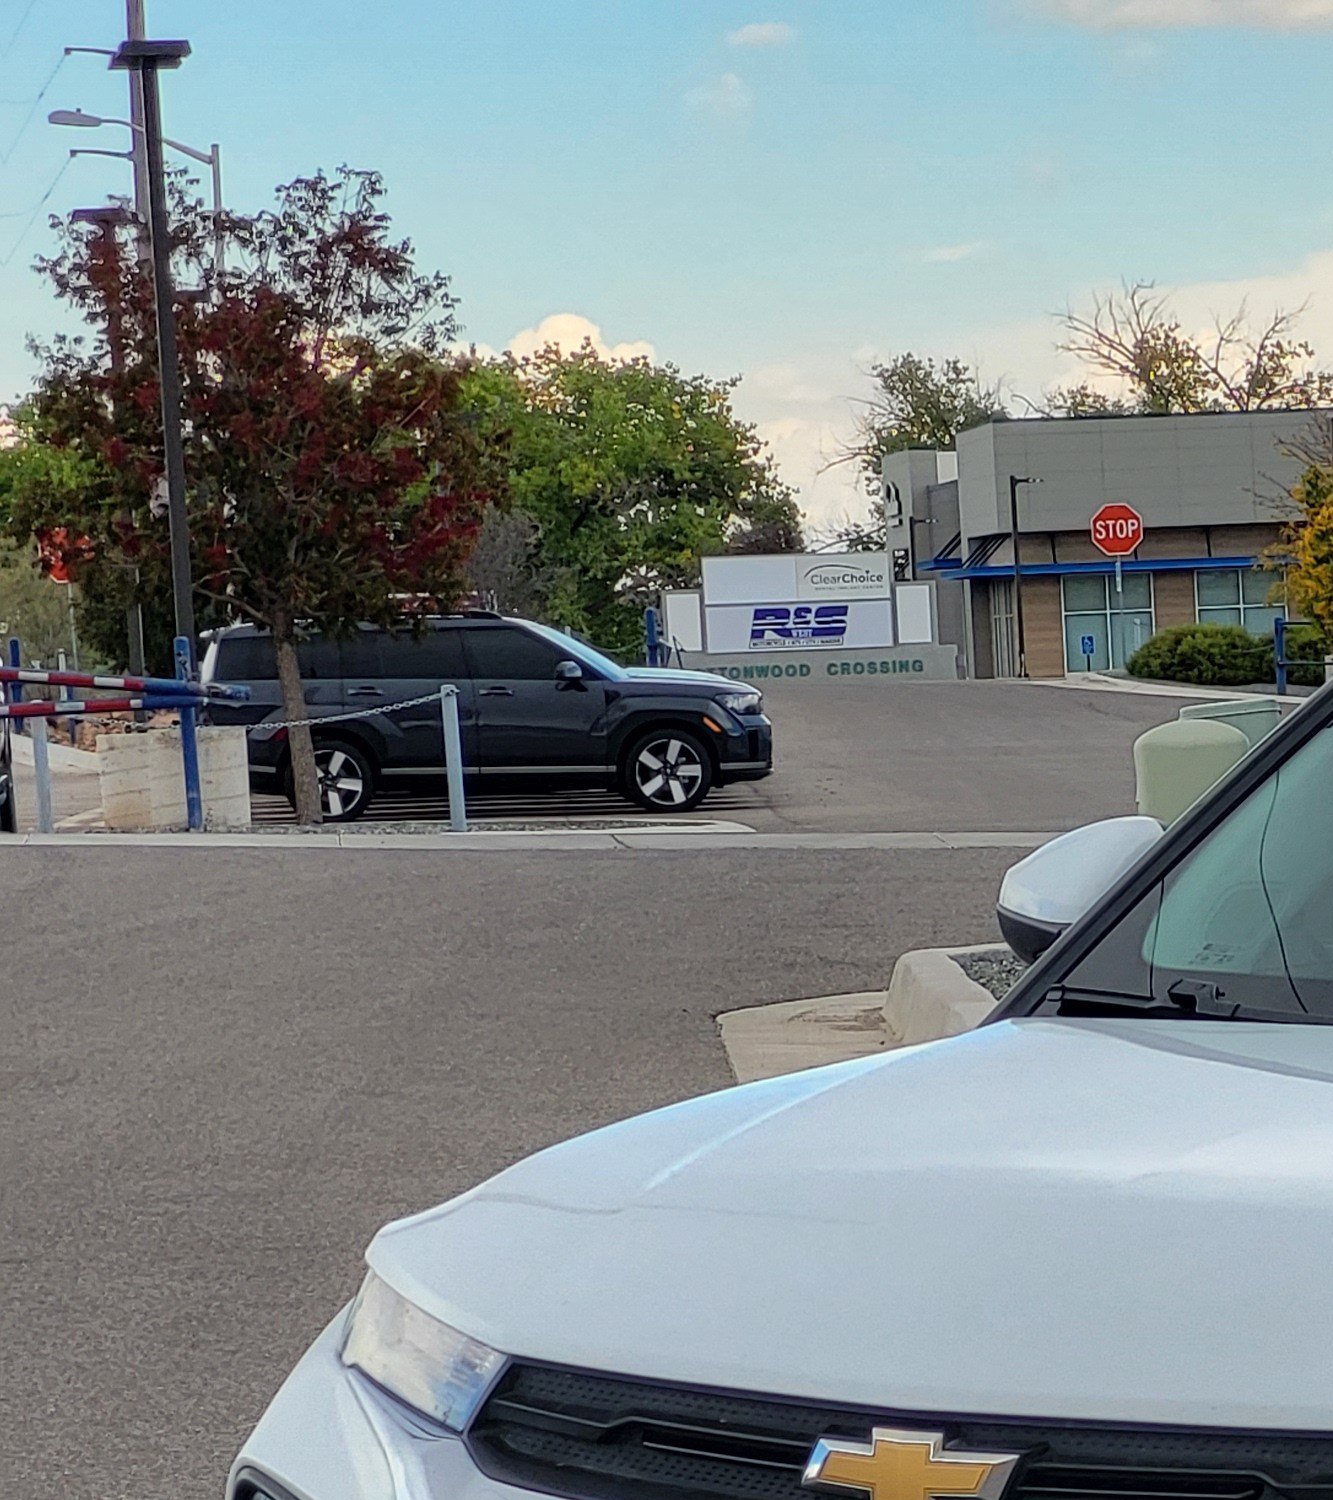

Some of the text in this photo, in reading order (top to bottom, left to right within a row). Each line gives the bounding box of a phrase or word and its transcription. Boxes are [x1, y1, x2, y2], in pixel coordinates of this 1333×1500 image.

[1096, 519, 1139, 539] STOP
[811, 570, 884, 585] ClearChoice
[826, 659, 925, 676] CROSSING
